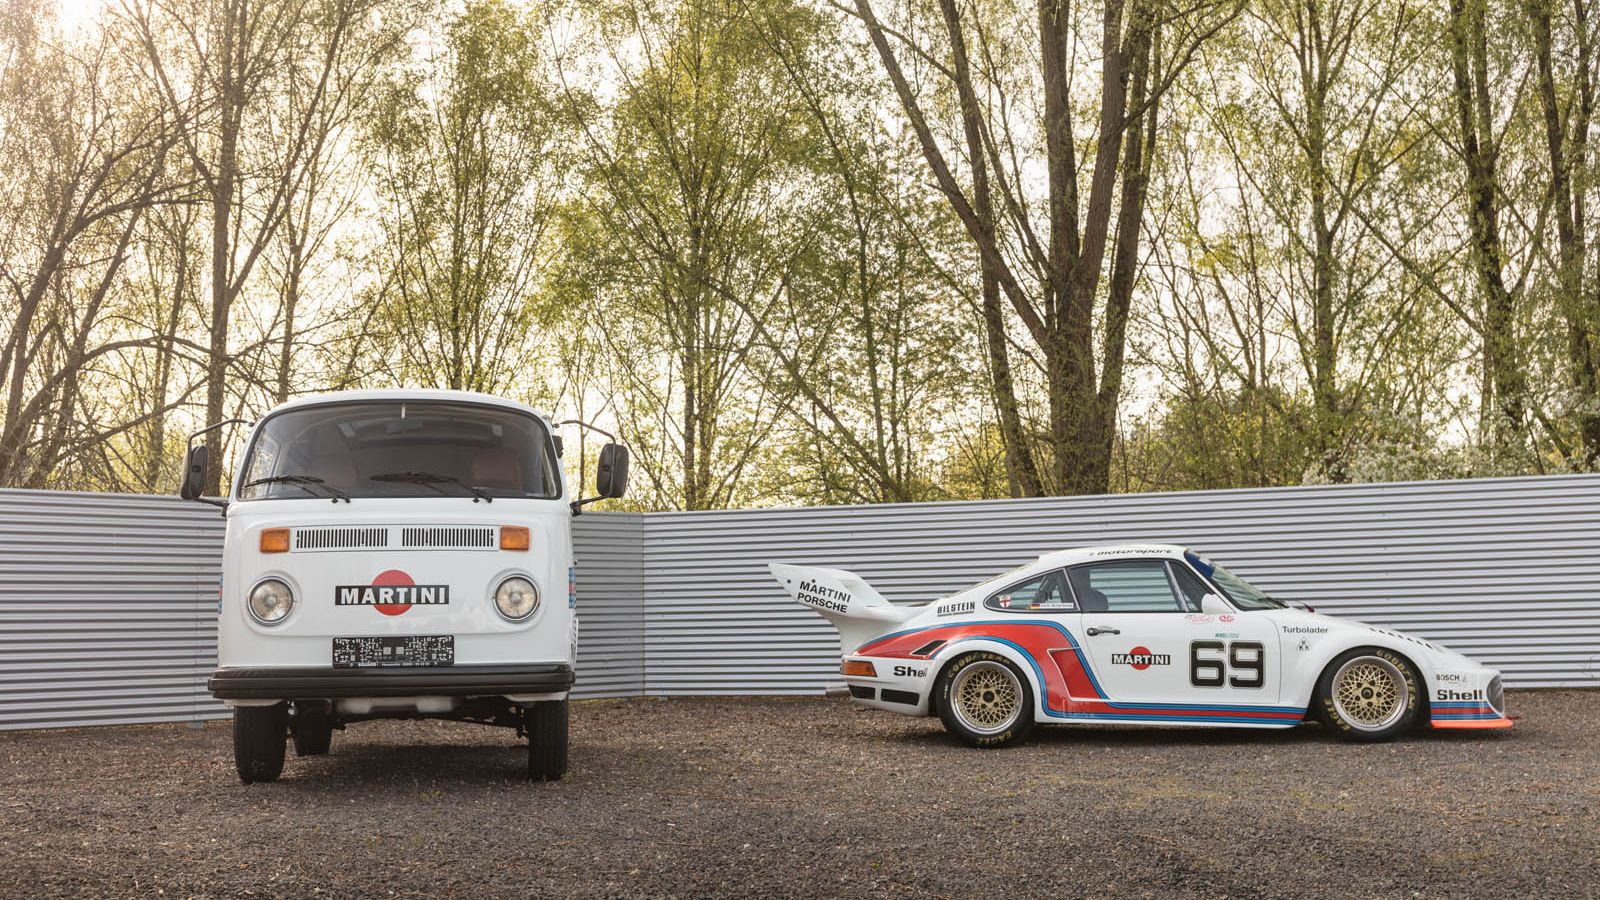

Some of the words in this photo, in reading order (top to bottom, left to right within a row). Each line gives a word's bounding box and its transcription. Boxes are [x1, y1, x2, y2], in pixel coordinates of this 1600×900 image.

[340, 587, 446, 604] MARTINI
[799, 580, 851, 603] MARTINI
[797, 592, 848, 613] PORSCHE
[937, 601, 975, 614] BILSTEIN
[1282, 625, 1328, 634] Turbolader
[1113, 654, 1170, 665] MARTINI
[1190, 640, 1265, 689] 69
[1437, 689, 1483, 701] Shell
